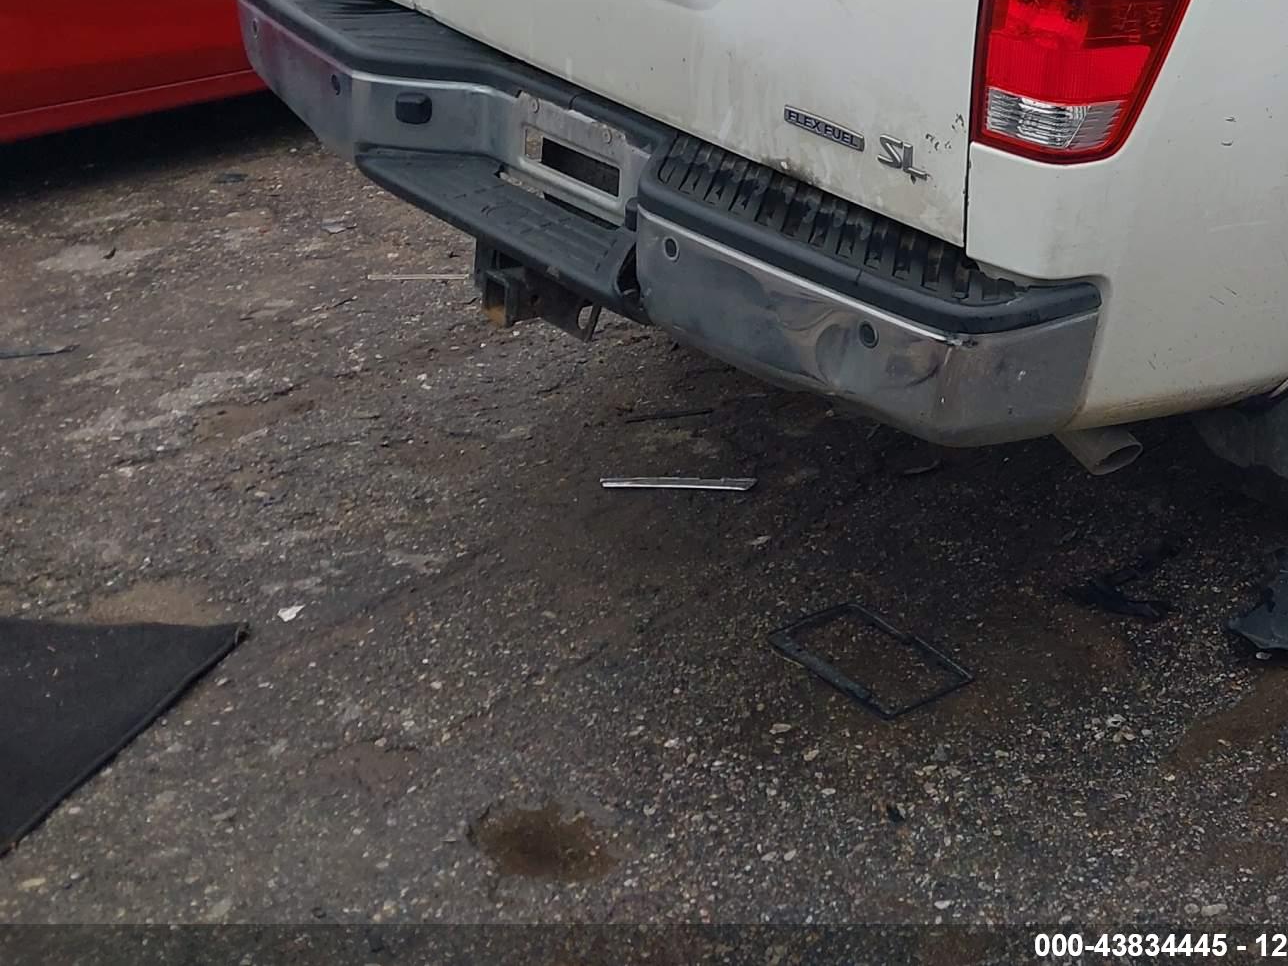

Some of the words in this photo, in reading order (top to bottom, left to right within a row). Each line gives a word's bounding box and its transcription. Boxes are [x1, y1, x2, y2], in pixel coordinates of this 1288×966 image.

[787, 109, 822, 133] FLEX
[823, 122, 859, 148] FUEL
[876, 133, 928, 181] SL
